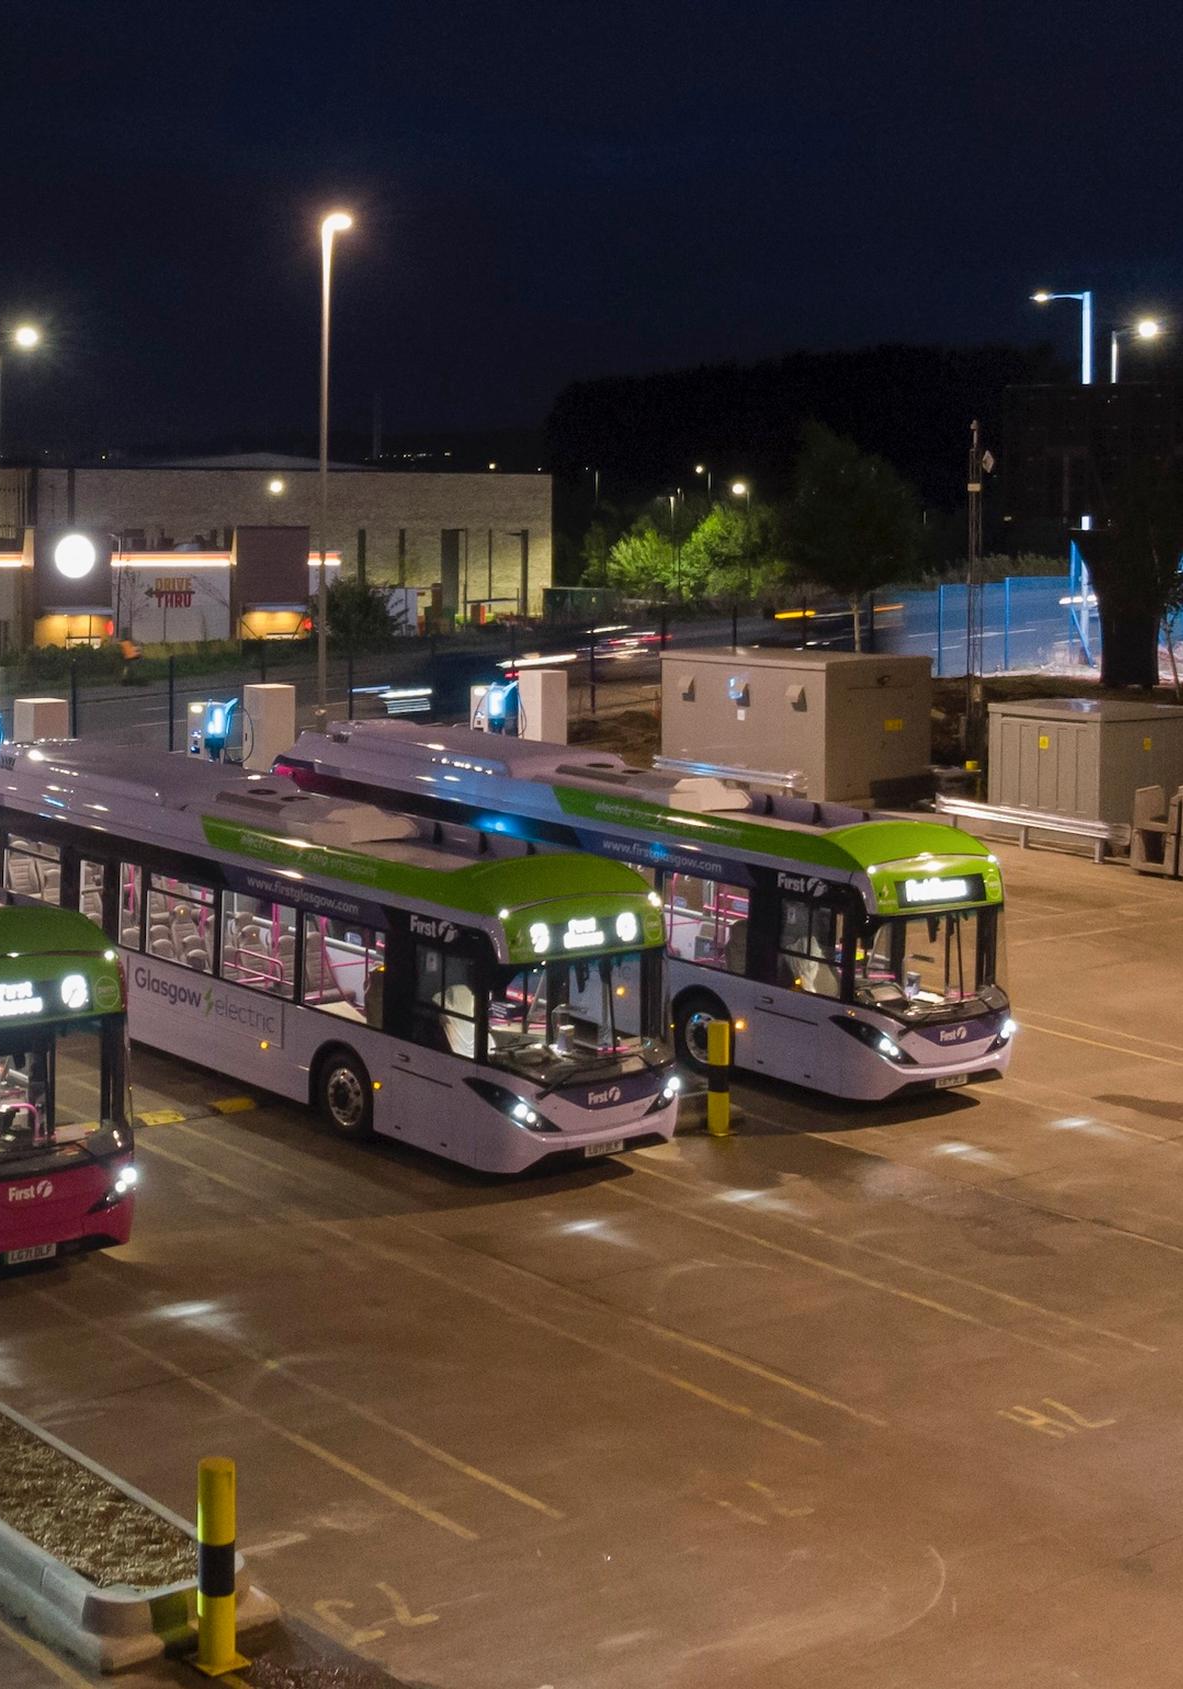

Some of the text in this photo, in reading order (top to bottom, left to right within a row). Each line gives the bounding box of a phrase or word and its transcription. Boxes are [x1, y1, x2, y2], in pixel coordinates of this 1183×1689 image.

[155, 577, 192, 591] DRIVE
[156, 591, 192, 608] THRU
[602, 838, 722, 874] www.firstglasgow.com
[777, 872, 806, 893] First
[247, 875, 359, 914] www.firstglasgow.com
[409, 914, 437, 938] First
[134, 966, 276, 1034] Glasgow electric
[940, 1030, 956, 1042] First
[588, 1091, 608, 1105] First
[8, 1185, 35, 1202] First
